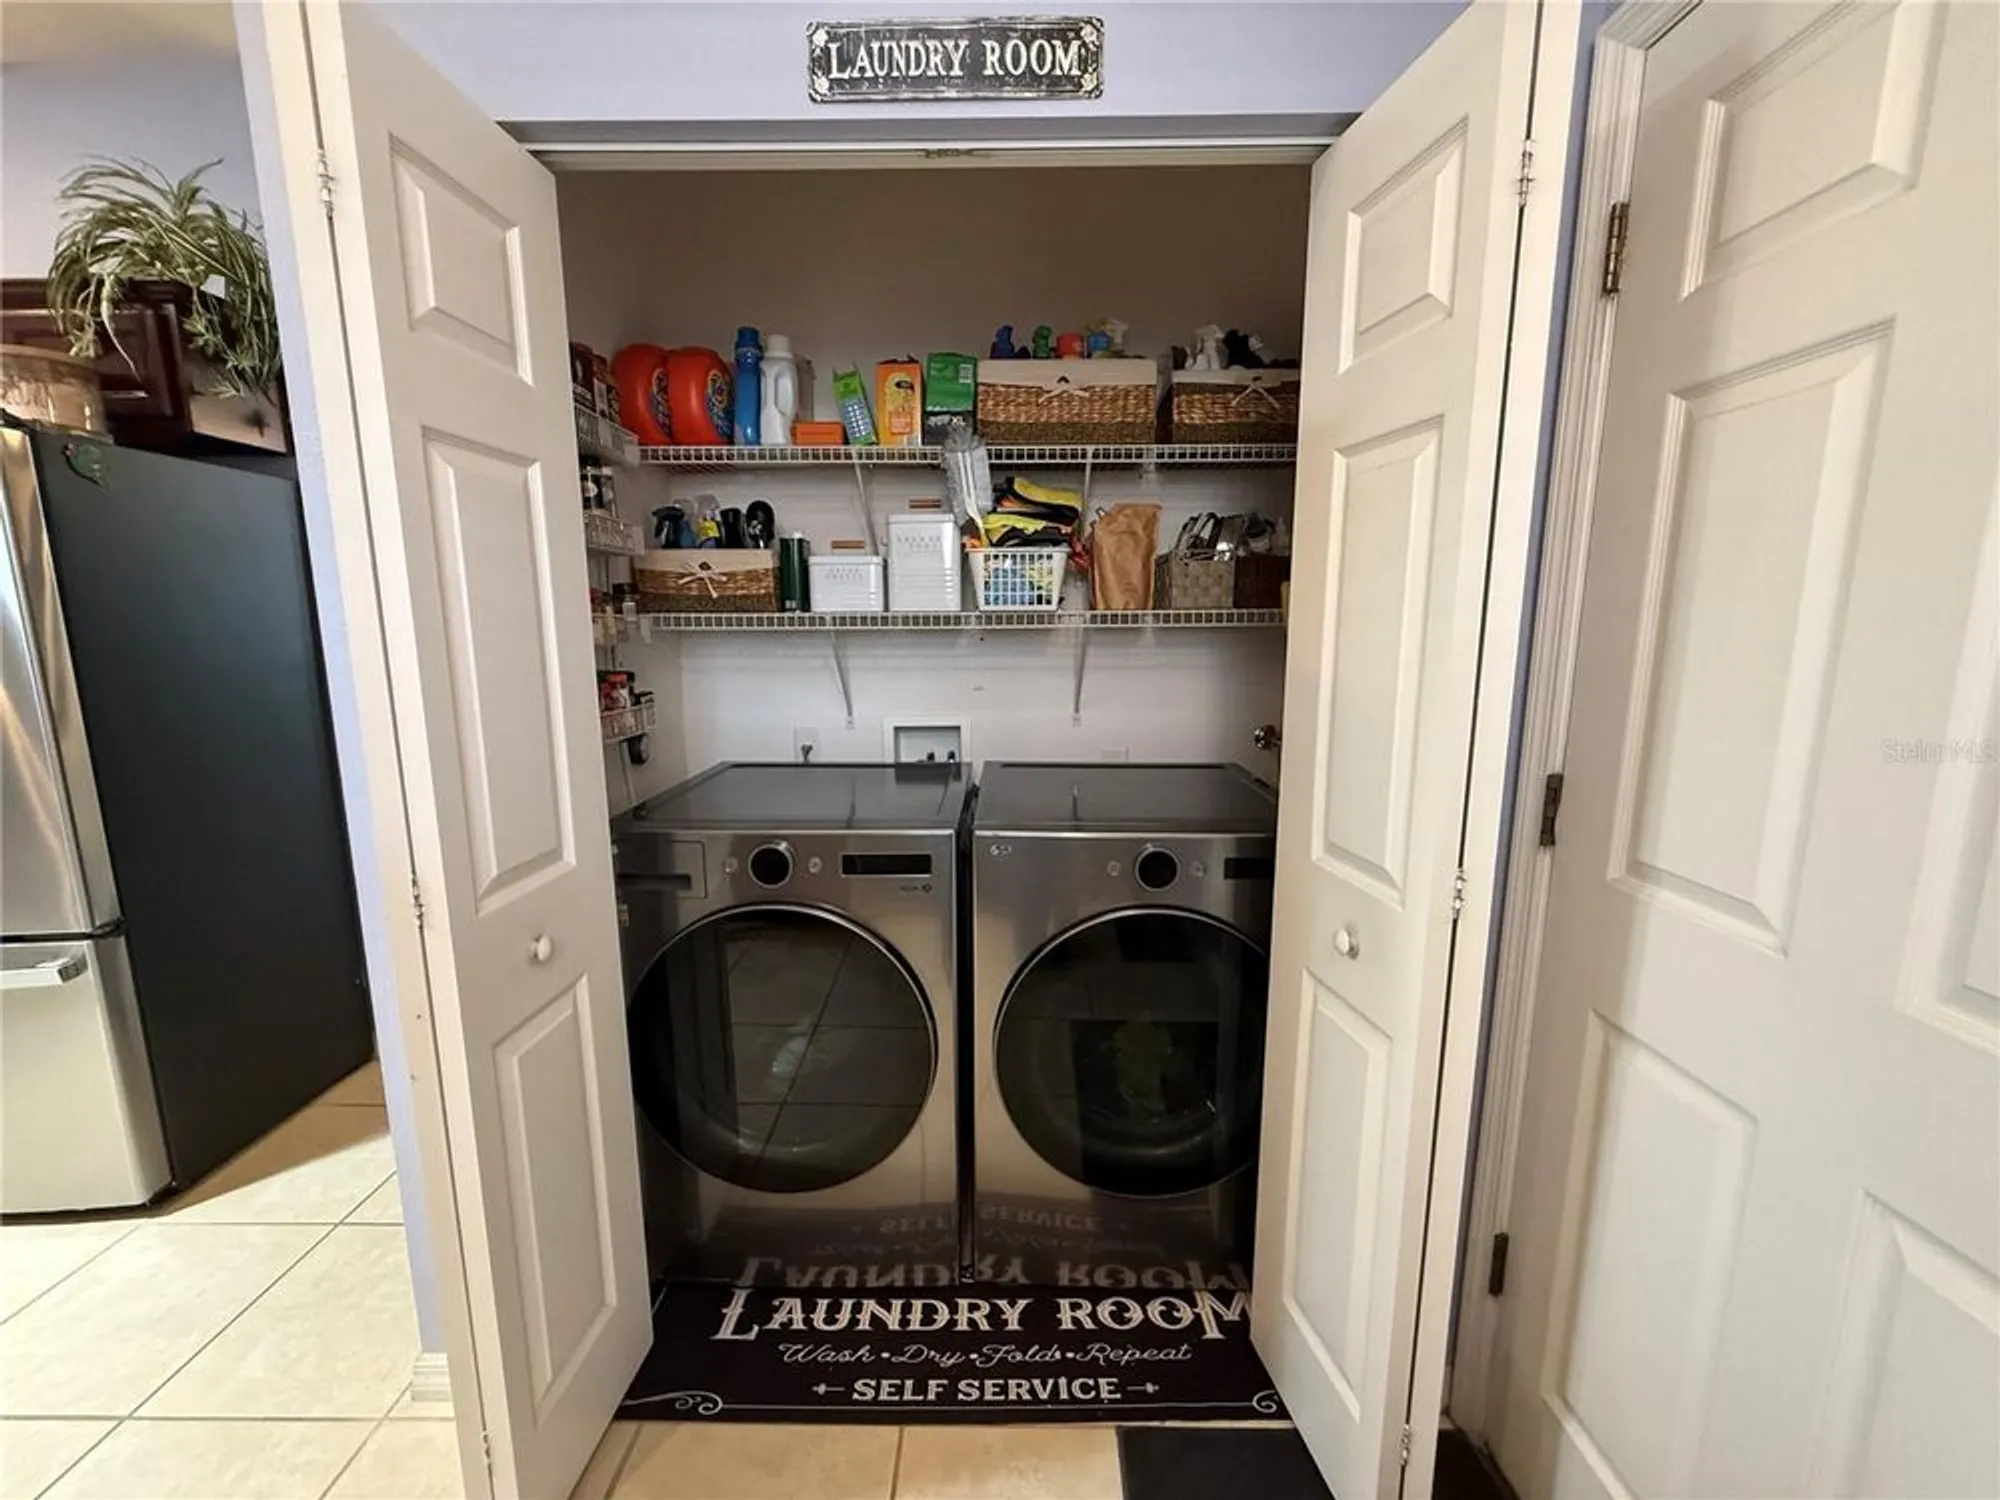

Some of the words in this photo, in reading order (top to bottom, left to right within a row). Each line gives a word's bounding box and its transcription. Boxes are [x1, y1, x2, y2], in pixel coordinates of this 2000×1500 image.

[827, 39, 969, 79] LAUNDRY
[982, 38, 1082, 76] ROOM
[710, 1288, 1034, 1341] LAUNDRY
[1056, 1290, 1254, 1340] ROOM
[777, 1343, 876, 1364] Wash
[890, 1343, 967, 1368] Dry
[975, 1343, 1060, 1368] Fold
[1076, 1342, 1192, 1367] Repeat
[852, 1378, 949, 1401] SELF
[957, 1376, 1122, 1401] SERVICE
